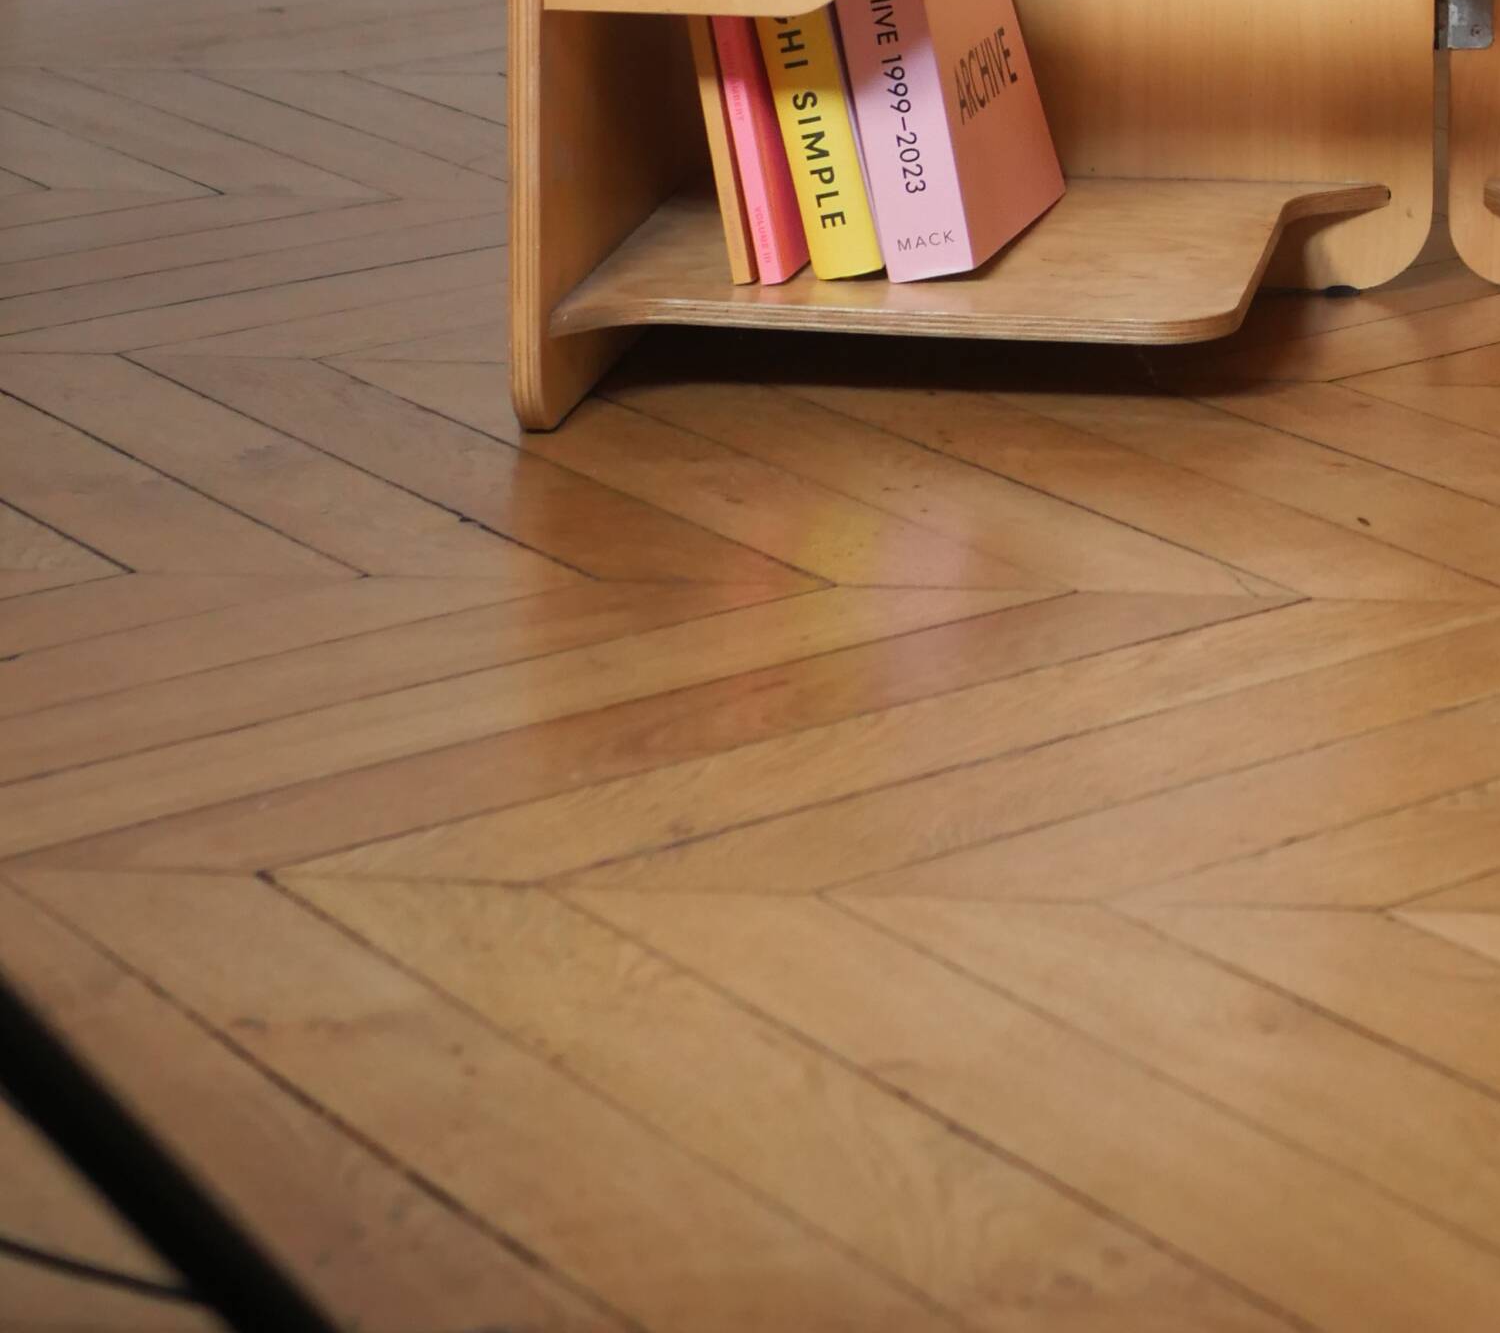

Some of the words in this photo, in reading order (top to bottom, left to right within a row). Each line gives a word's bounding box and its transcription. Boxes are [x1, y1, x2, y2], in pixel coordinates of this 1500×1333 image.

[774, 17, 809, 70] HI
[792, 91, 846, 230] SIMPLE
[953, 27, 1018, 126] ARCHIVE
[897, 229, 955, 253] MACK
